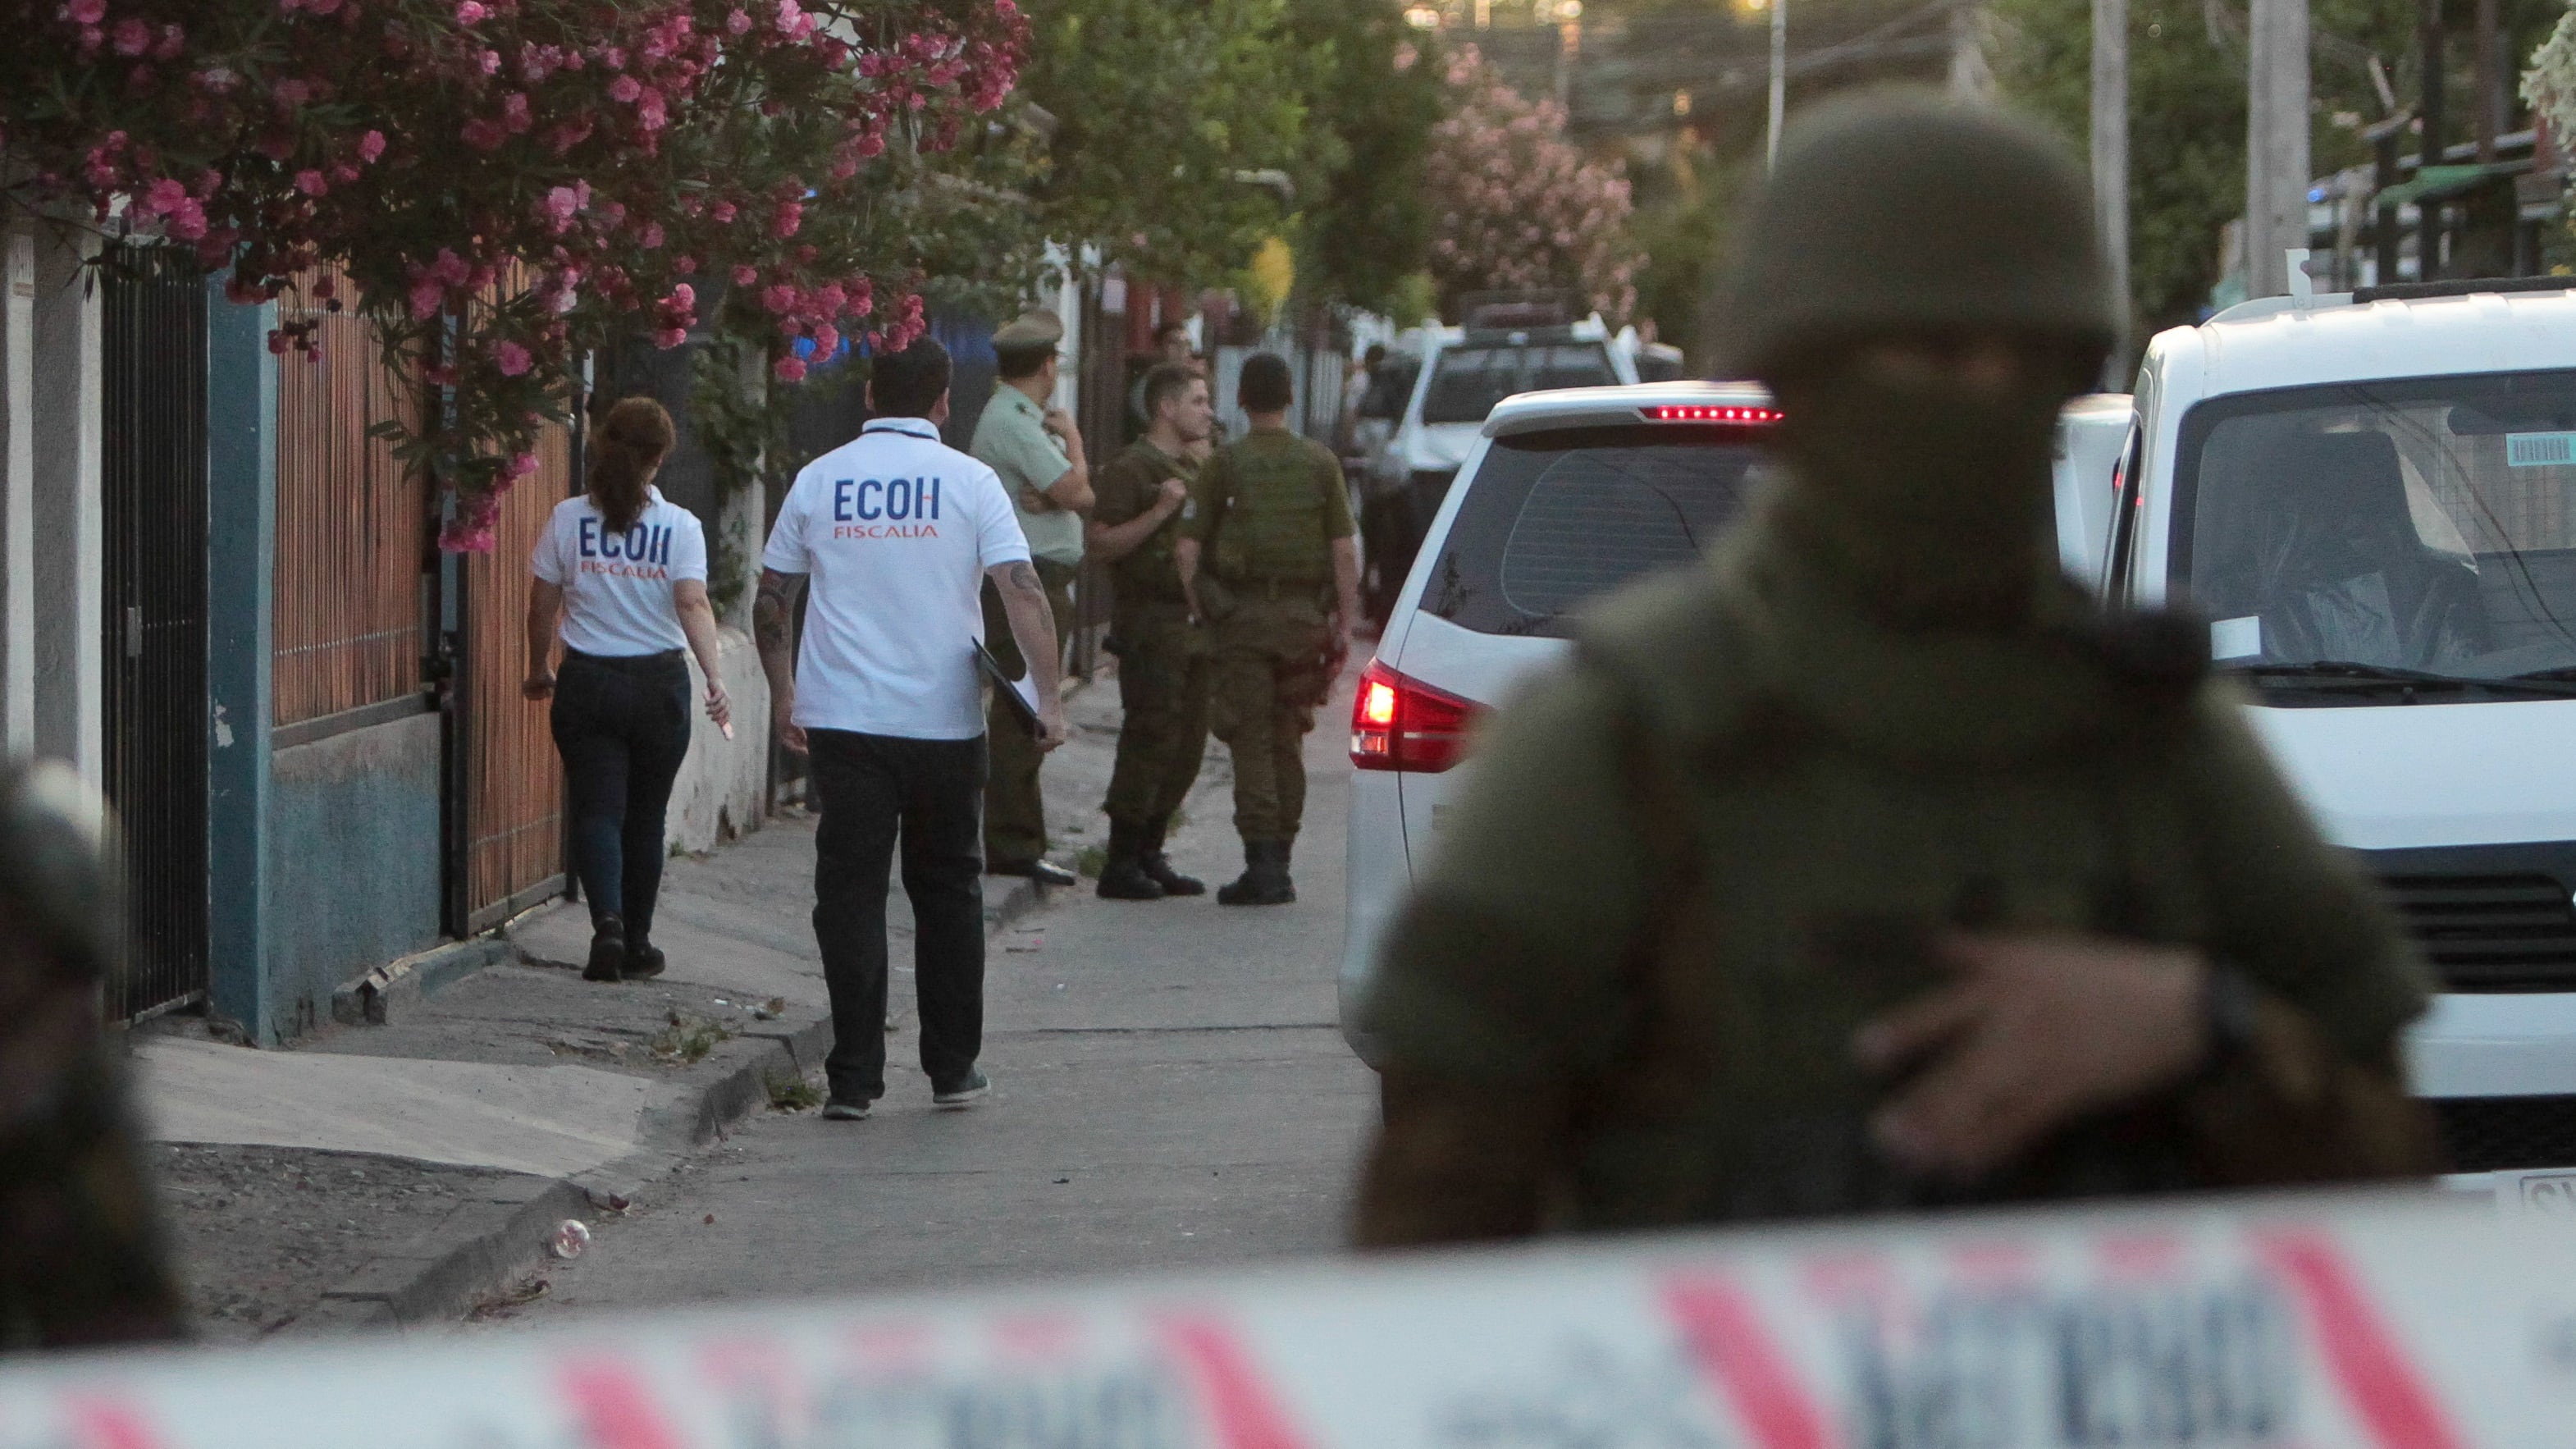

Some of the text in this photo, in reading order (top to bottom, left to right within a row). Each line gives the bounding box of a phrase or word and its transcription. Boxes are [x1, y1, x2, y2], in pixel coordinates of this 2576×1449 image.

[834, 478, 940, 522] ECOH
[579, 516, 672, 565] ECOH
[834, 524, 939, 539] FISCALIA
[580, 560, 669, 578] FISCALIA
